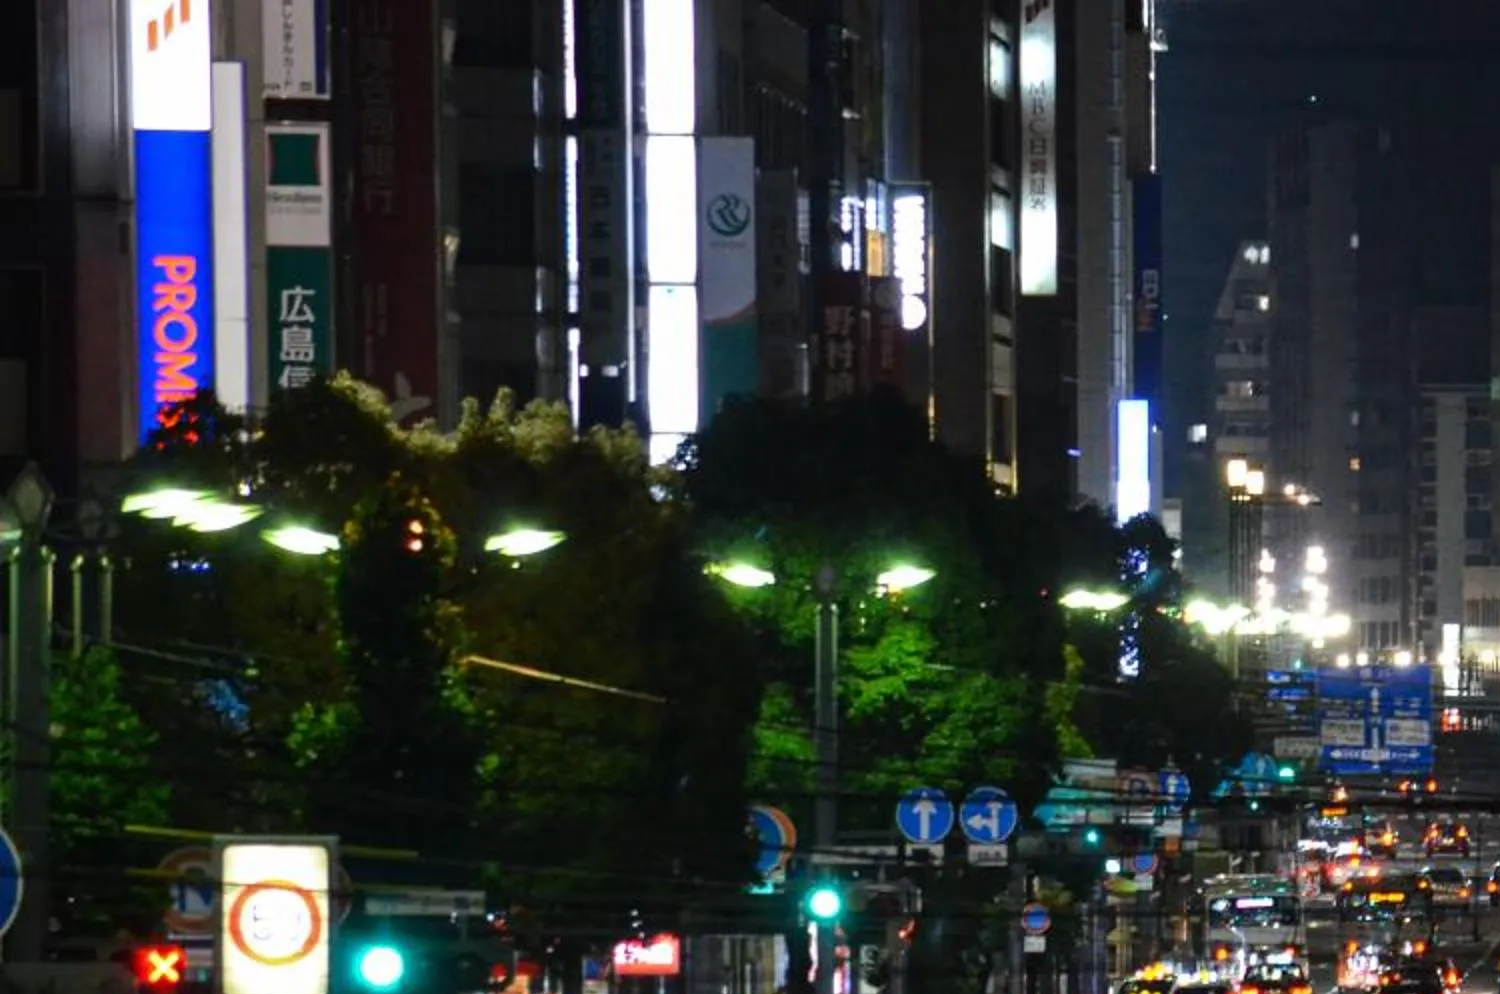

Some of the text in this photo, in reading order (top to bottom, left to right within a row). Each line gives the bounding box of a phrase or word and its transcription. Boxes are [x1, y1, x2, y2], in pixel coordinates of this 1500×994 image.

[1028, 78, 1047, 210] MBC日興証券
[153, 255, 198, 446] PROMI
[279, 285, 317, 389] 広島信
